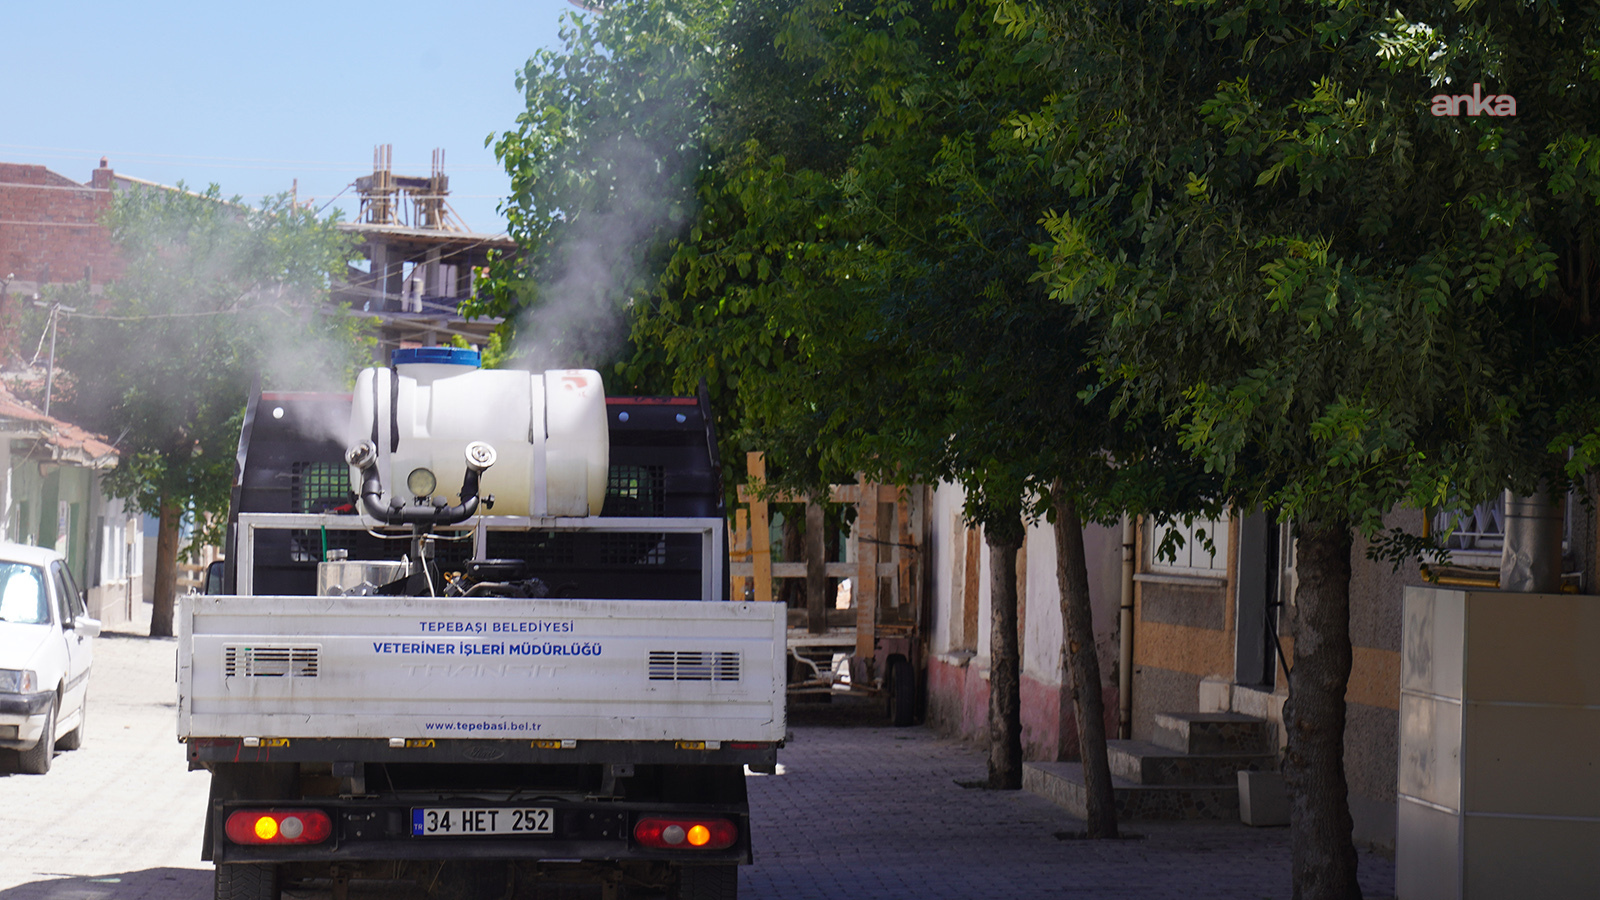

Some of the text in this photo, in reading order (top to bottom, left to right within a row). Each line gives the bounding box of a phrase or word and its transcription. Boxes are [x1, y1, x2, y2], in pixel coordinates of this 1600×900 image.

[419, 619, 574, 634] TEPEBAŞI BELEDİYESİ
[373, 640, 602, 657] VETERİNER İŞLERİ MÜDÜRLÜĞÜ
[425, 721, 542, 731] www.tepebasi.bel.tr
[413, 809, 549, 832] TR 34 HET 252
